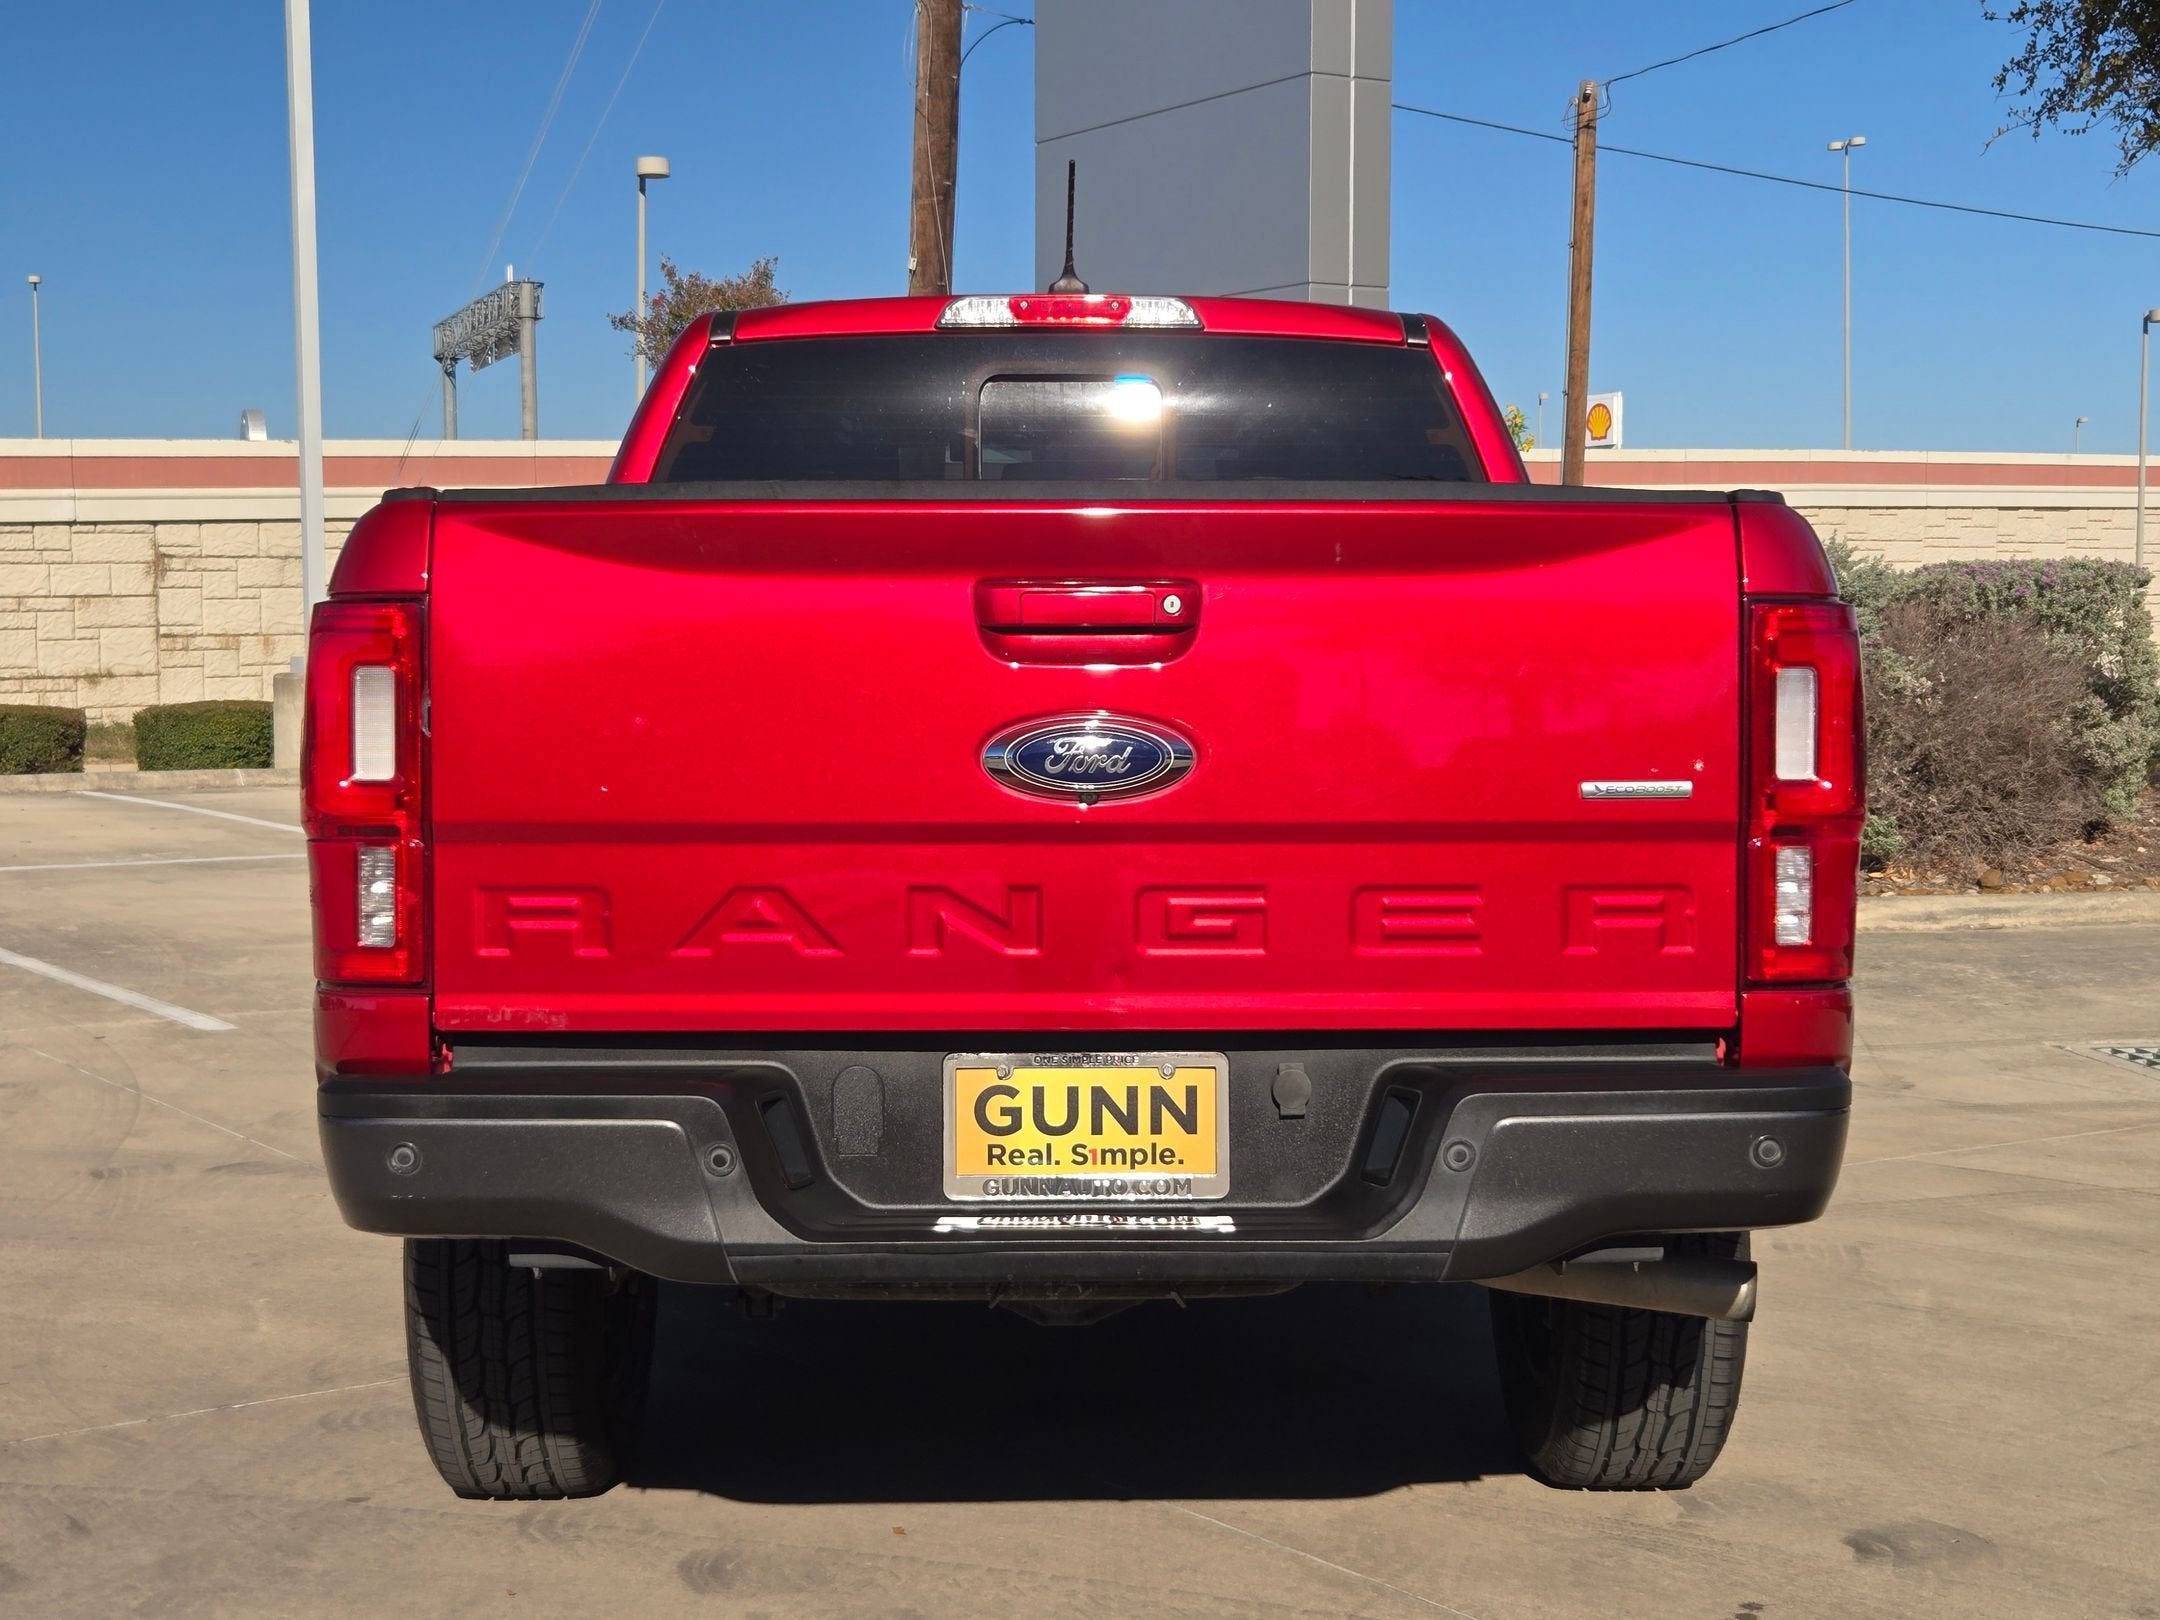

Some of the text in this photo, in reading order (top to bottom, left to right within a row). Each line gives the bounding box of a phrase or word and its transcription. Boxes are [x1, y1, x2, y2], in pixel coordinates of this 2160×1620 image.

[1044, 736, 1133, 774] Ford
[1605, 785, 1683, 794] ECOBOOST
[474, 883, 1696, 957] RANGER
[1033, 1055, 1140, 1064] ONE SIMPLE PRICE
[974, 1084, 1198, 1137] GUNN
[987, 1143, 1061, 1166] Real.
